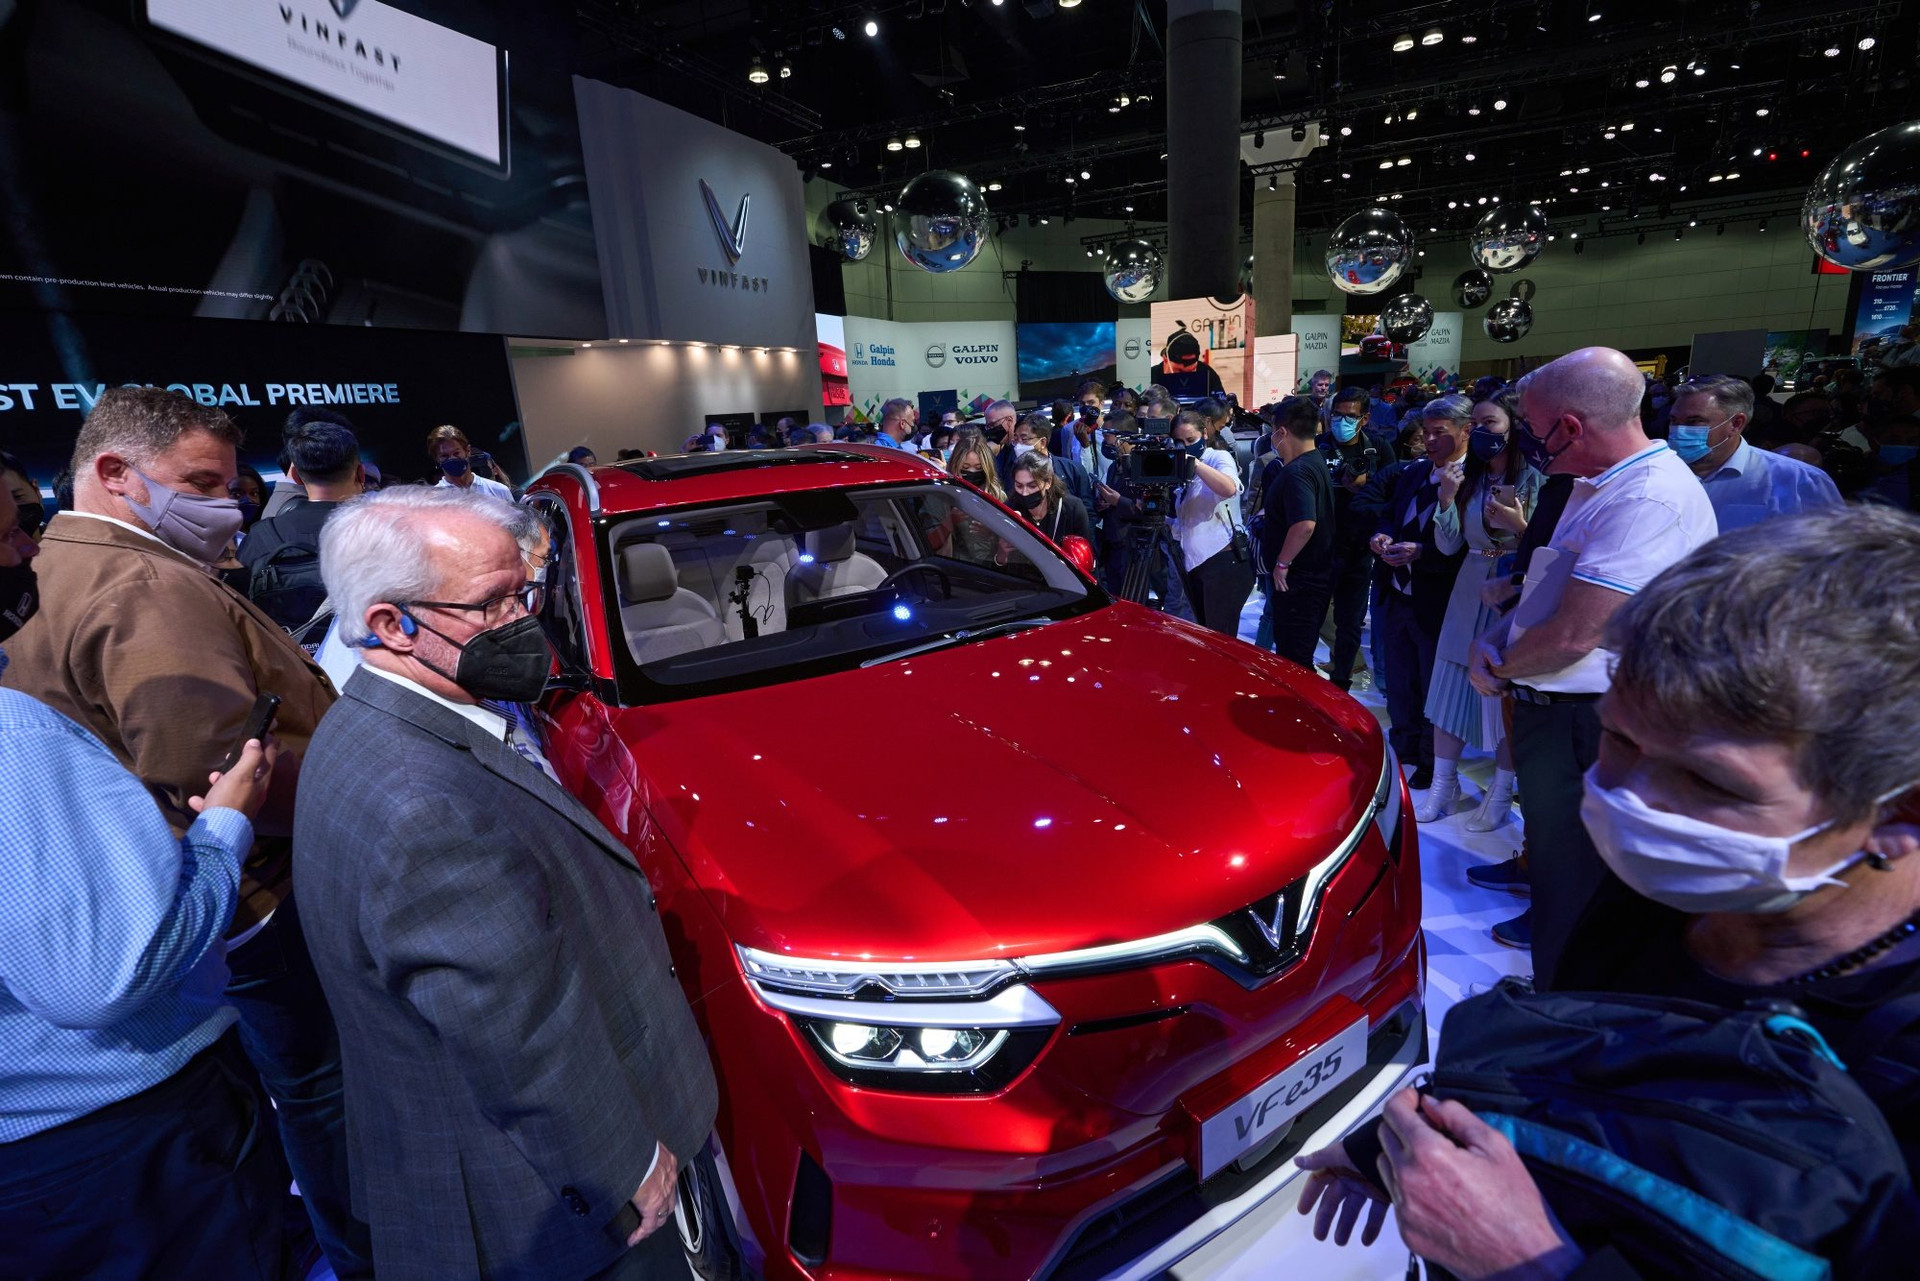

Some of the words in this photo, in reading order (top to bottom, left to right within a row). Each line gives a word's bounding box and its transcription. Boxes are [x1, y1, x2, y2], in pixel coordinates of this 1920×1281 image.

[279, 2, 401, 74] VINFAST
[697, 266, 769, 293] VINFAST
[1871, 273, 1908, 283] FRONTIER
[14, 274, 44, 282] contain
[100, 280, 117, 288] level
[147, 284, 168, 292] Actual
[168, 286, 202, 295] production
[203, 289, 226, 297] vehicles
[1304, 332, 1328, 341] GALPIN
[1430, 328, 1451, 336] GALPIN
[1304, 342, 1328, 350] MAZDA
[1430, 337, 1450, 345] MAZDA
[869, 343, 895, 356] Galpin
[952, 344, 999, 353] GALPIN
[870, 356, 896, 366] Honda
[954, 355, 998, 364] VOLVO
[265, 383, 400, 406] PREMIERE
